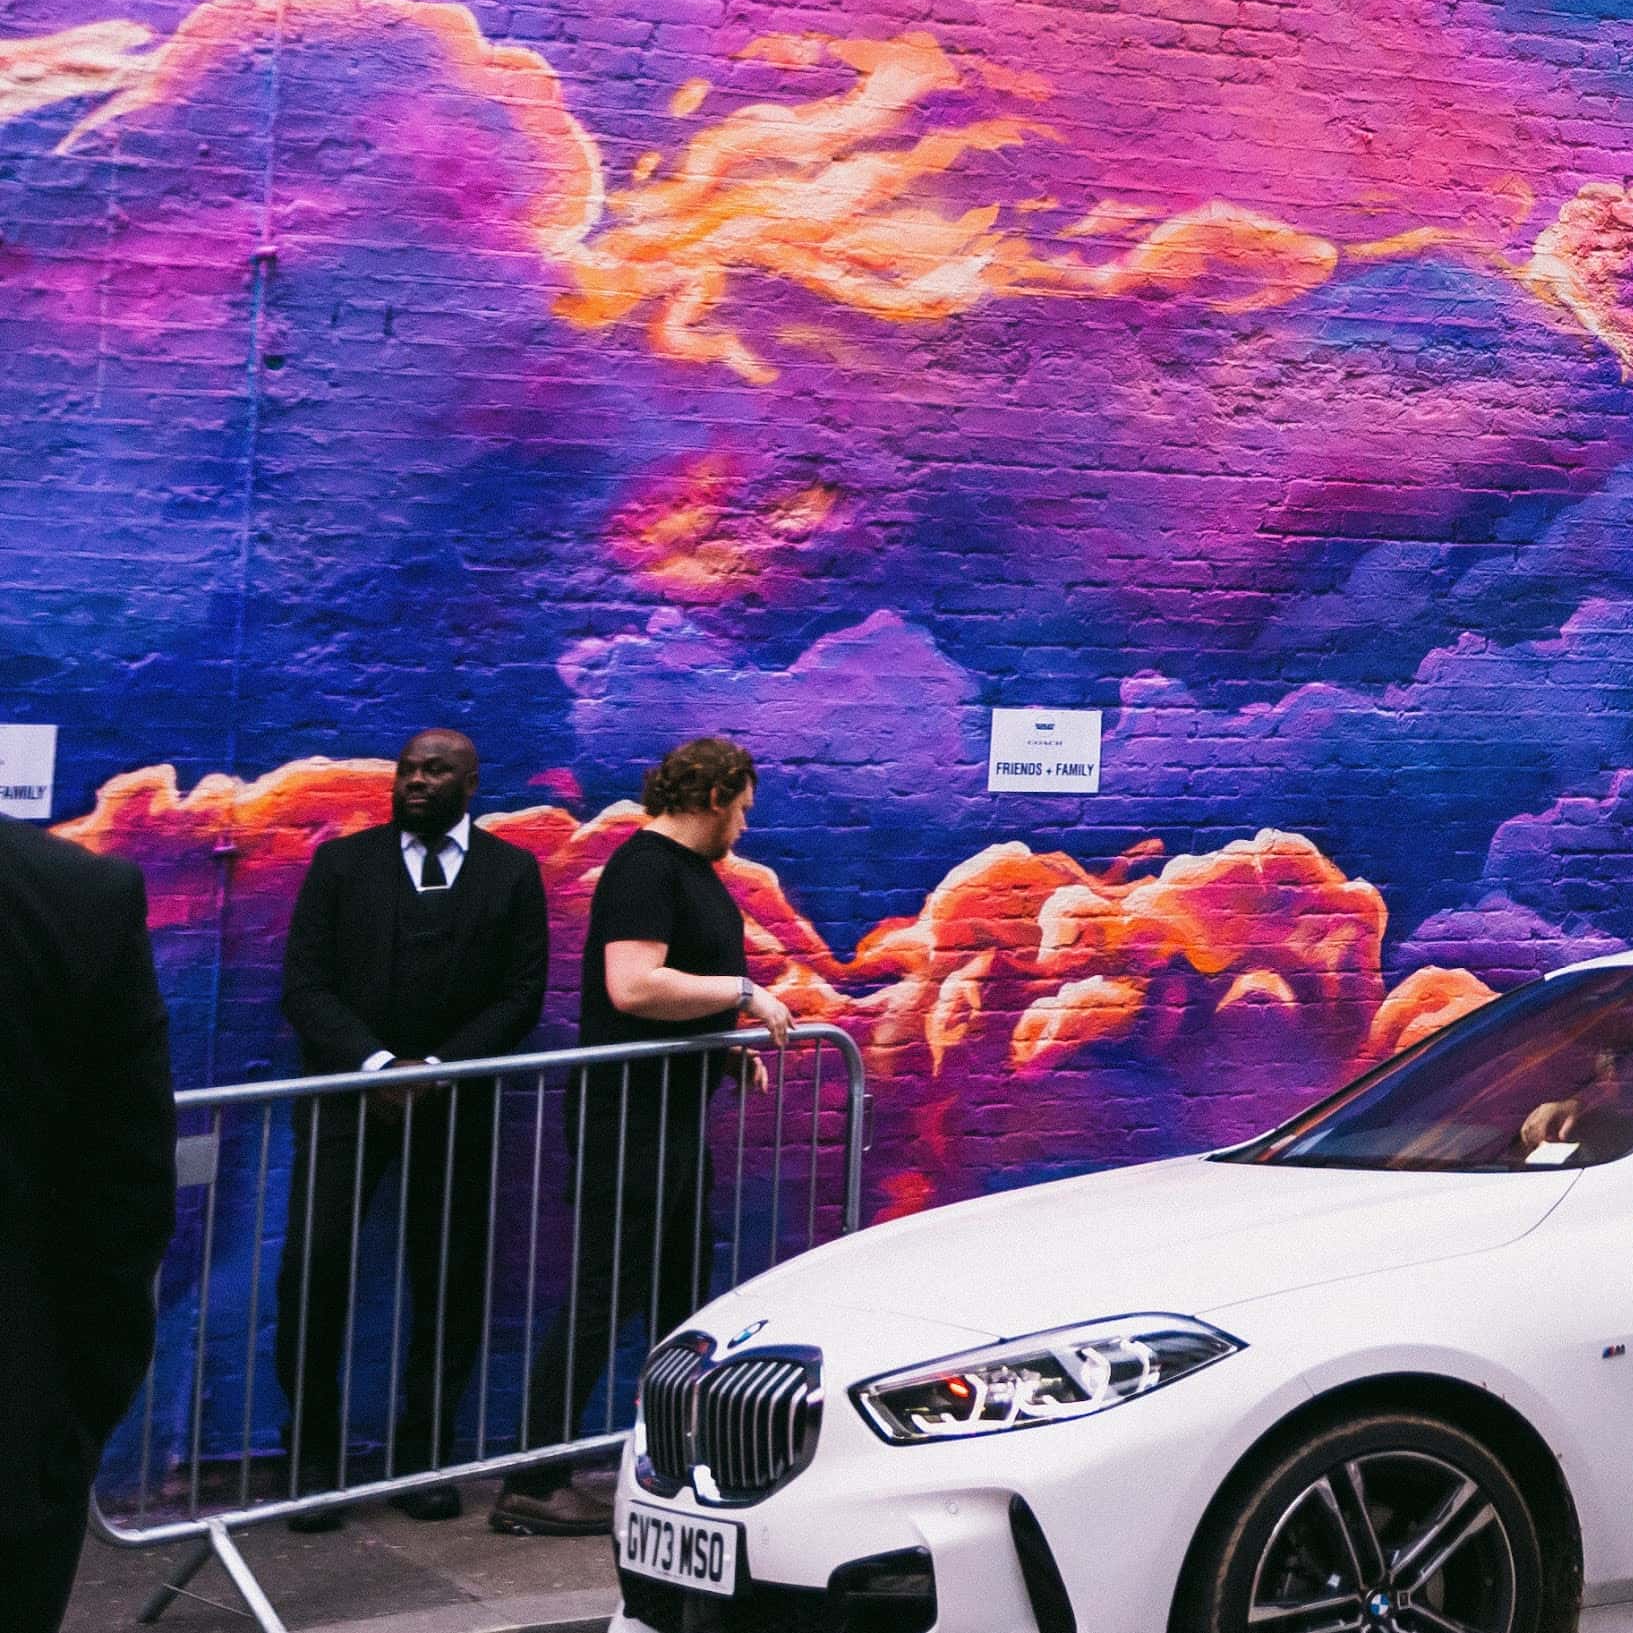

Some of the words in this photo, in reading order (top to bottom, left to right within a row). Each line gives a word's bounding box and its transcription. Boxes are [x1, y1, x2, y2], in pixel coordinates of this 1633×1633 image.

[996, 762, 1042, 776] FRIENDS
[1056, 763, 1095, 777] FAMILY
[679, 1525, 724, 1582] MSO
